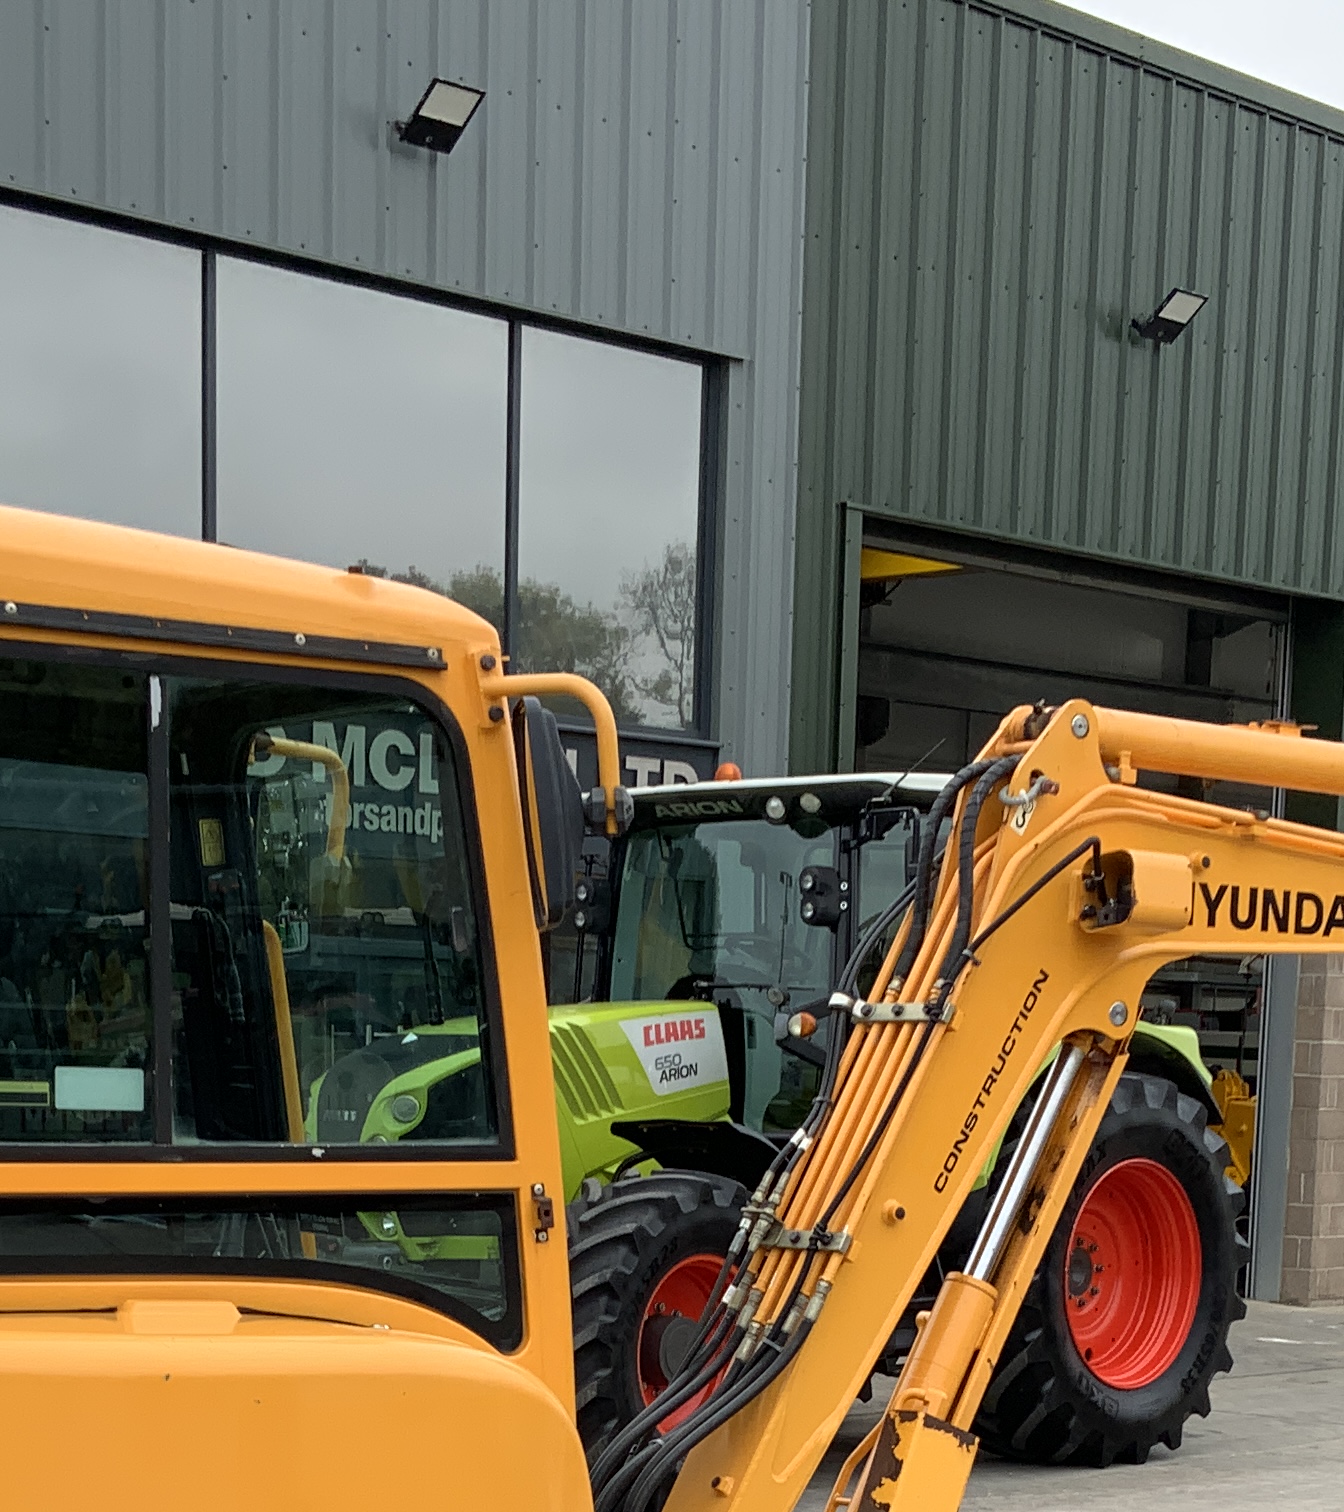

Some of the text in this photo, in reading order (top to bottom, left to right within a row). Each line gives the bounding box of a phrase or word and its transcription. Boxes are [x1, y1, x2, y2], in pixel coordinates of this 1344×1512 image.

[312, 720, 440, 795] MCL
[625, 755, 700, 789] TD
[655, 800, 744, 819] ARION
[642, 1018, 706, 1048] CLAAS
[655, 1053, 682, 1071] 650
[659, 1062, 698, 1084] ARION
[933, 968, 1050, 1194] CONSTRUCTION
